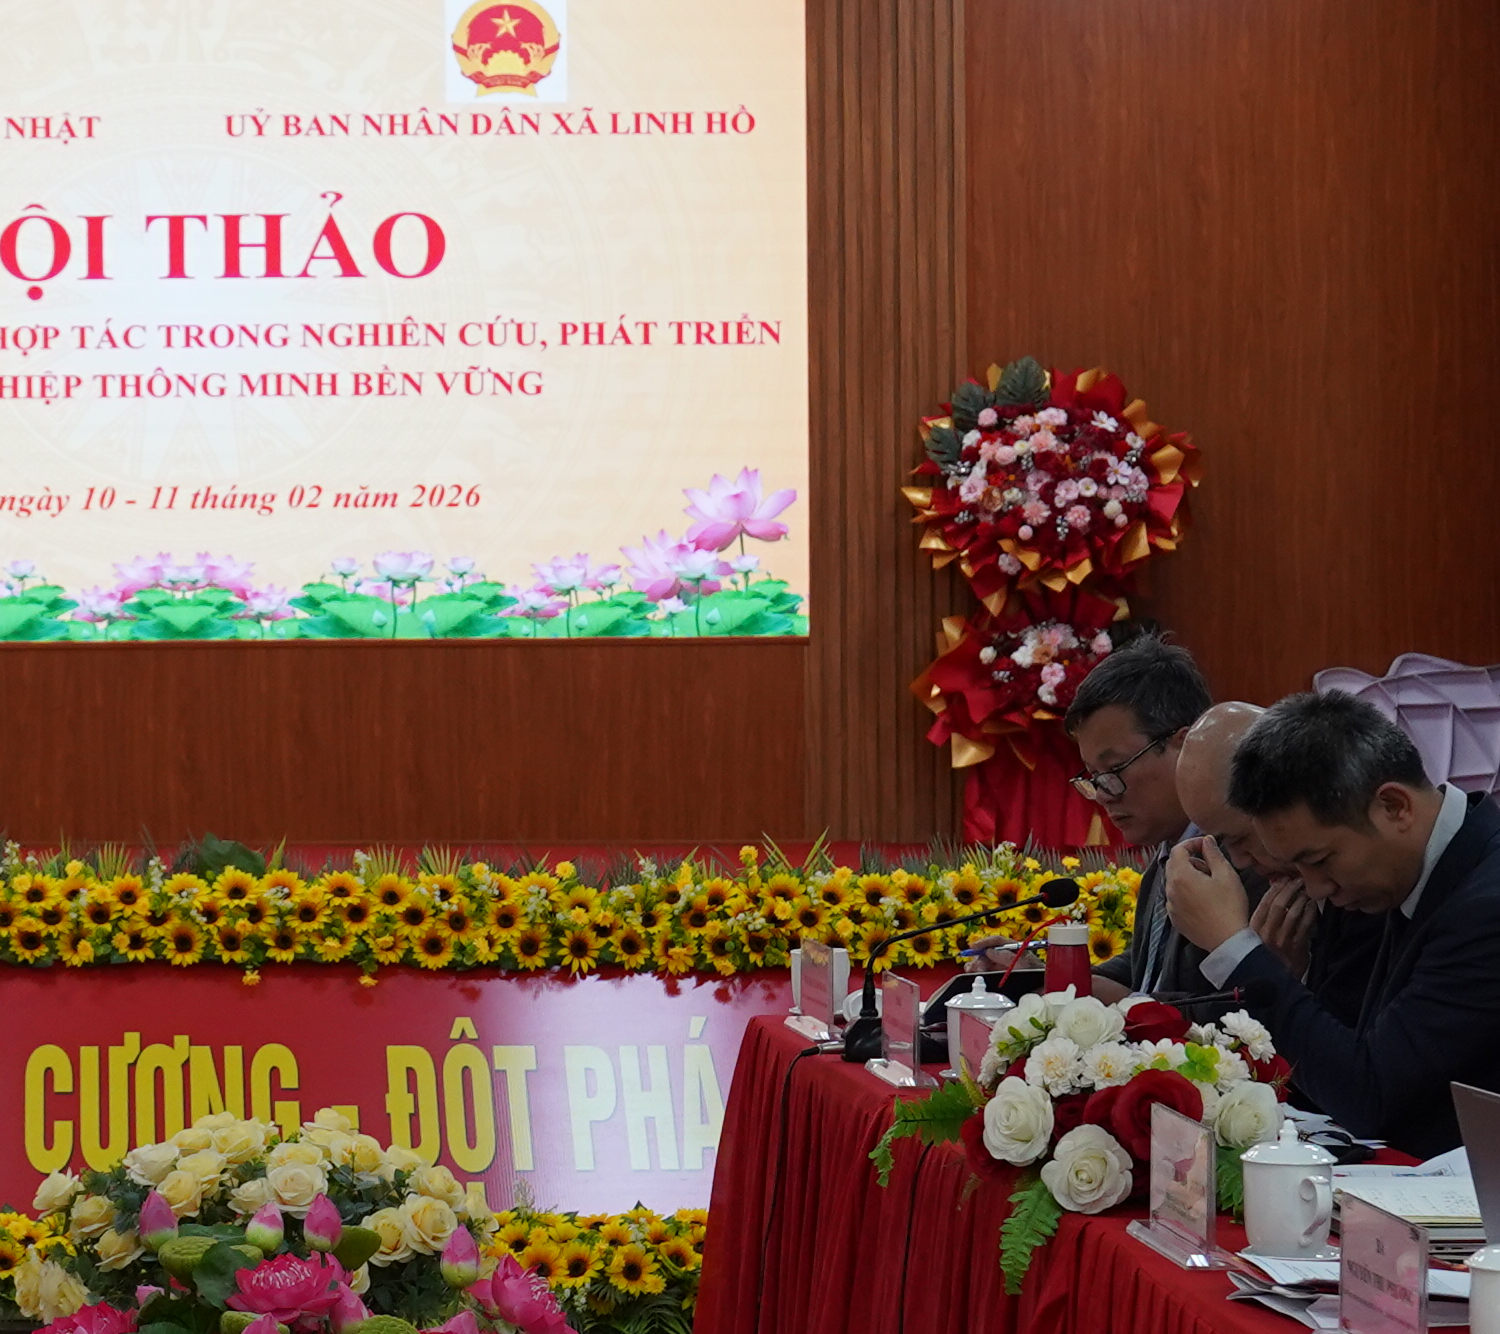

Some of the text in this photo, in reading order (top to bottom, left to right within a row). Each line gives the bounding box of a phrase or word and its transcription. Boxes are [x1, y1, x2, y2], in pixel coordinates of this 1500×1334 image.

[5, 116, 100, 145] NHẬT
[226, 104, 757, 137] UỶ BAN NHÂN DÂN XÃ LINH HỒ
[145, 191, 447, 279] THẢO
[72, 318, 146, 350] TÁC
[158, 324, 290, 349] TRONG
[302, 316, 446, 347] NGHIÊN
[458, 315, 548, 351] CỨU,
[560, 314, 658, 347] PHÁT
[668, 311, 783, 346] TRIỂN
[94, 367, 226, 398] THÔNG
[240, 373, 339, 397] MINH
[352, 365, 424, 397] BỀN
[436, 365, 543, 396] VỮNG
[83, 487, 117, 510] 10
[150, 486, 179, 509] 11
[190, 485, 277, 515] tháng
[288, 485, 324, 509] 02
[332, 486, 399, 509] năm
[409, 484, 481, 508] 2026
[563, 1015, 726, 1173] PHÁ
